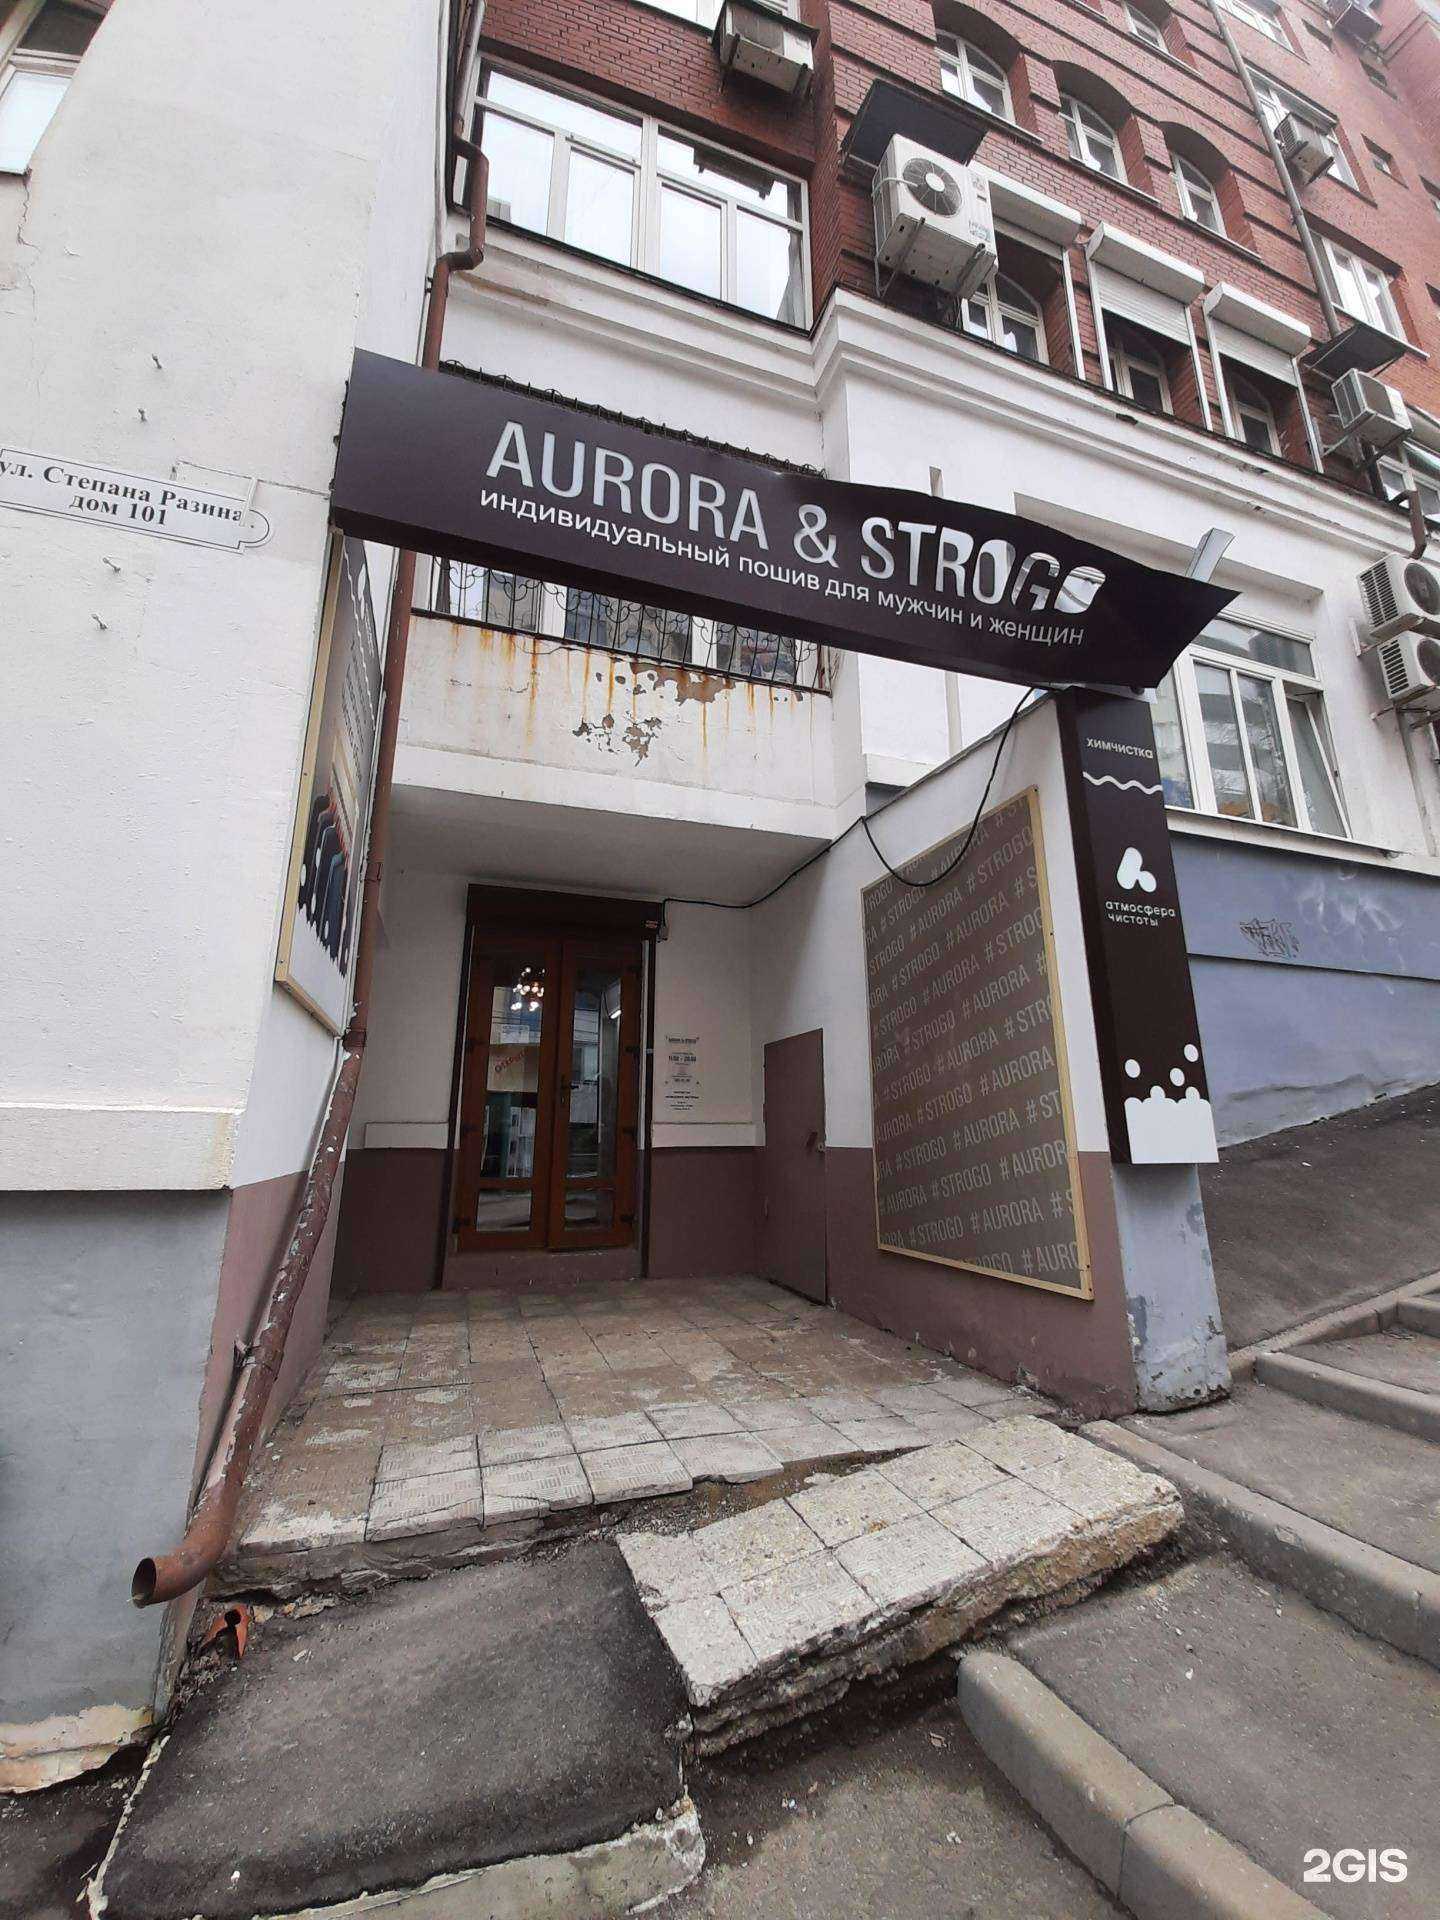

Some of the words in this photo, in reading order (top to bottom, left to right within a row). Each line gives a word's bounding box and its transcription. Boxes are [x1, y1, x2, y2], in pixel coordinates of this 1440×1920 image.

[43, 465, 151, 503] Степана
[160, 489, 243, 522] Разина
[69, 494, 118, 516] дом
[129, 503, 167, 526] 101
[486, 420, 770, 551] AURORA
[793, 503, 839, 569] &
[860, 516, 1107, 614] STROGO
[480, 488, 730, 569] индивидуальный
[739, 556, 820, 591] пошив
[825, 577, 870, 603] для
[878, 589, 963, 626] мужчин
[970, 612, 983, 630] и
[989, 615, 1085, 648] женщин
[1086, 737, 1154, 760] химчистка
[1105, 900, 1177, 919] атмосфера
[1107, 912, 1159, 927] чистоты
[977, 1044, 1055, 1097] #AURORA
[969, 1196, 1045, 1236] #AURORA
